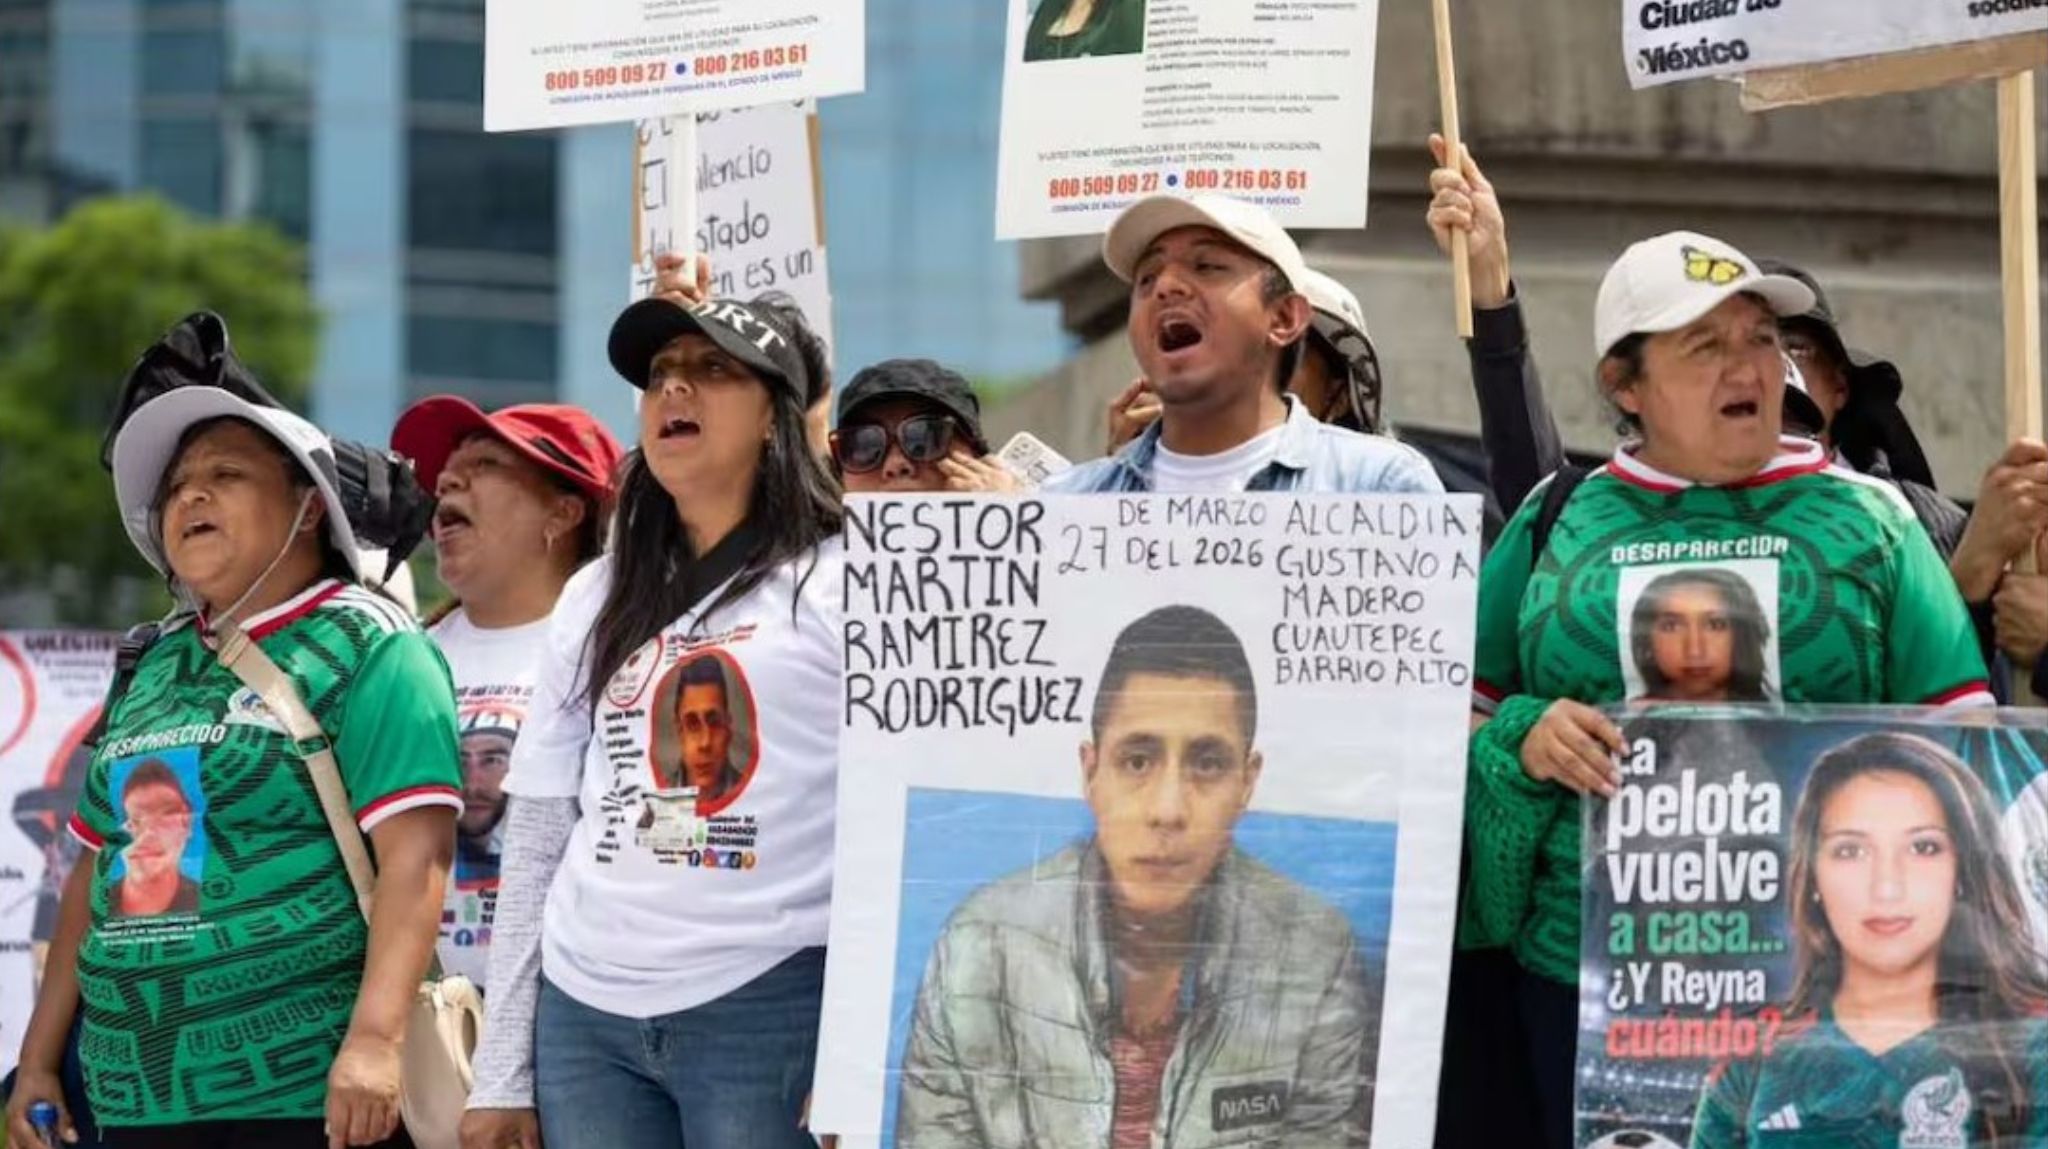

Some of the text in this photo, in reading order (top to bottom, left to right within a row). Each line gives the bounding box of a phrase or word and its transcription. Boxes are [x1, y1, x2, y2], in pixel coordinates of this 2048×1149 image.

[545, 44, 807, 91] 800 509 09 27 800 216 03 61
[1638, 38, 1749, 74] México
[641, 145, 772, 210] El ilencio
[1049, 169, 1307, 198] 800 509 09 27 800 216 03 61
[696, 198, 770, 253] stado
[745, 257, 776, 289] es
[785, 248, 813, 279] un
[843, 500, 1045, 554] NESTOR
[1118, 497, 1267, 528] DE MARZO
[1058, 523, 1264, 575] 27 DEL 2026
[1275, 544, 1476, 580] GUSTAVO A
[843, 554, 1040, 614] MARTIN
[1283, 584, 1425, 618] MADERO
[844, 612, 1057, 671] RAMIREZ
[1273, 621, 1445, 655] CUAUTEPEC
[1276, 658, 1469, 687] BARRIO ALTO
[845, 673, 1083, 737] RODRIGUEZ
[101, 723, 227, 760] DESAPARECIDO
[1606, 769, 1782, 850] pelota
[1606, 837, 1779, 904] vuelve
[1609, 910, 1785, 955] a casa...
[1607, 962, 1766, 1011] ¿Y Reyna
[1606, 1007, 1783, 1058] cuándo?
[1220, 1093, 1280, 1120] NASA
